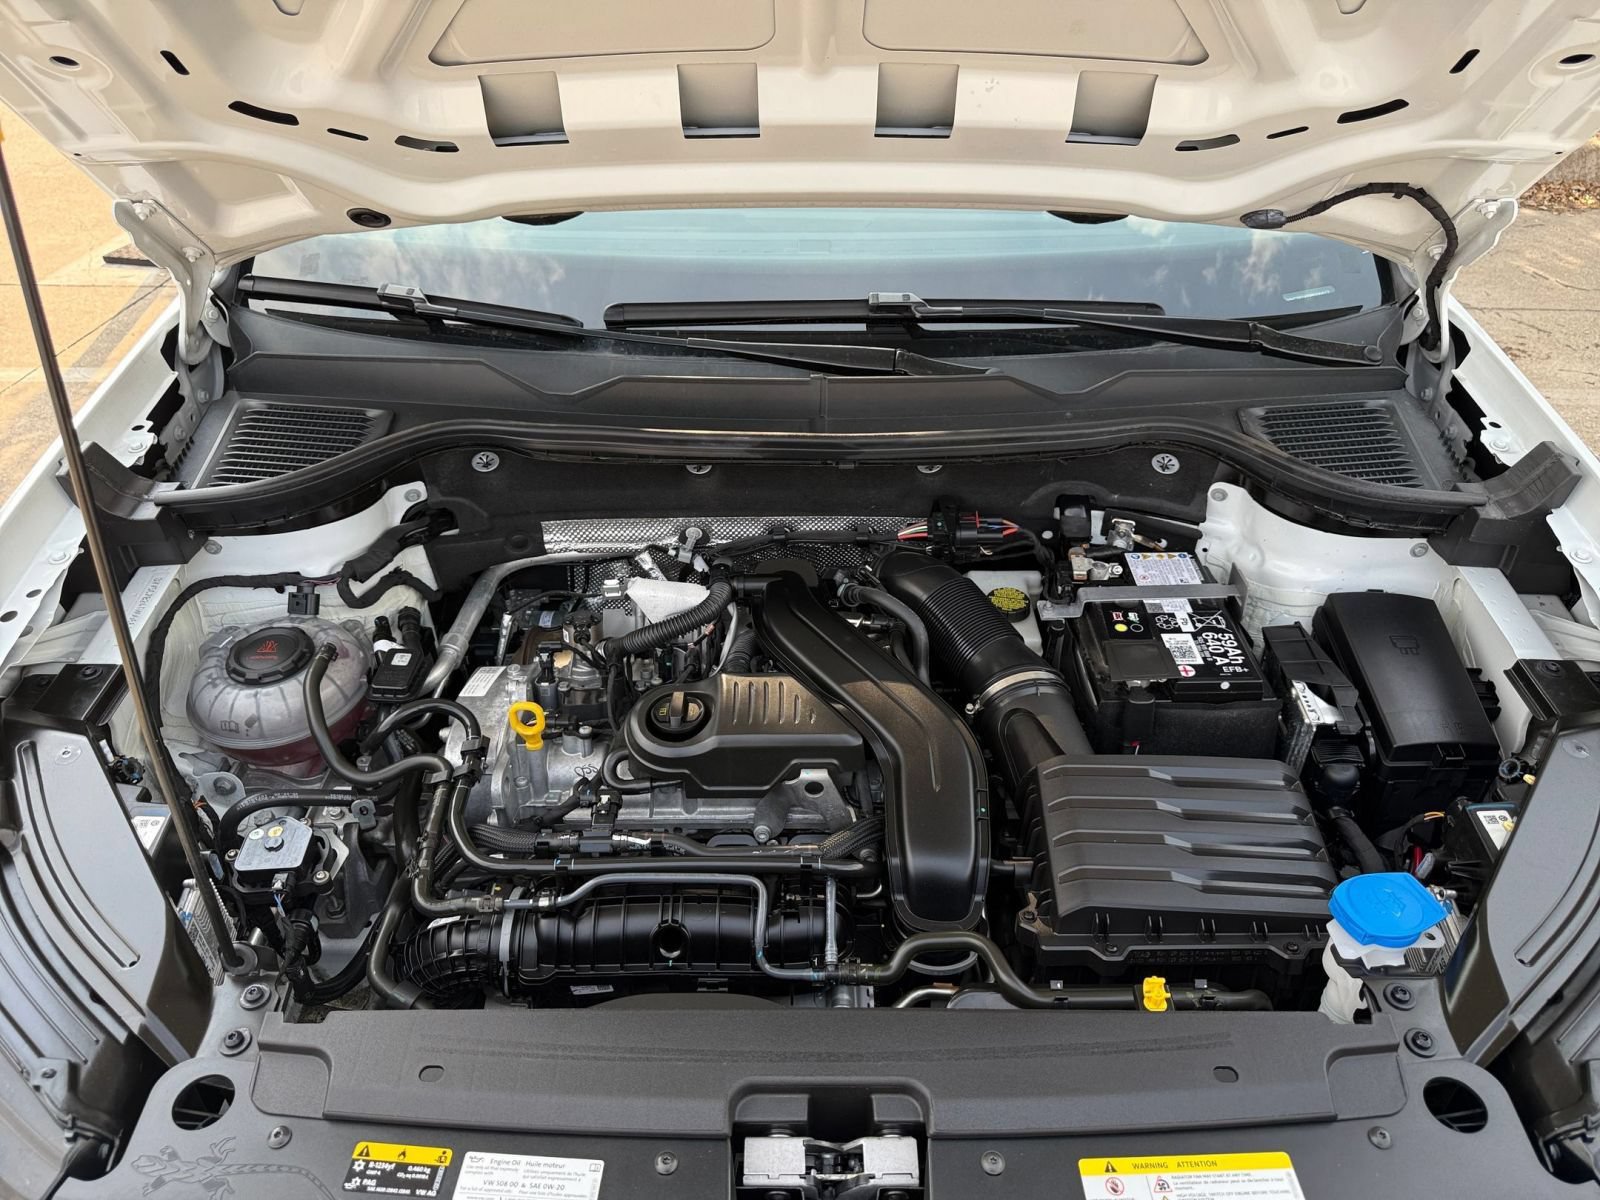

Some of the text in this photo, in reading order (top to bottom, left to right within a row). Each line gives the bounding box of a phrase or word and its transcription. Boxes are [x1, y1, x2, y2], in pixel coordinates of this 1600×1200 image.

[1201, 631, 1225, 653] 640
[1218, 633, 1246, 664] 59Ah
[1222, 665, 1250, 673] EFB+
[490, 1158, 511, 1167] Engine
[525, 1160, 542, 1168] Huile
[1131, 1160, 1218, 1170] WARNING ATTENTION
[483, 1179, 495, 1187] VW
[529, 1182, 541, 1190] SAE
